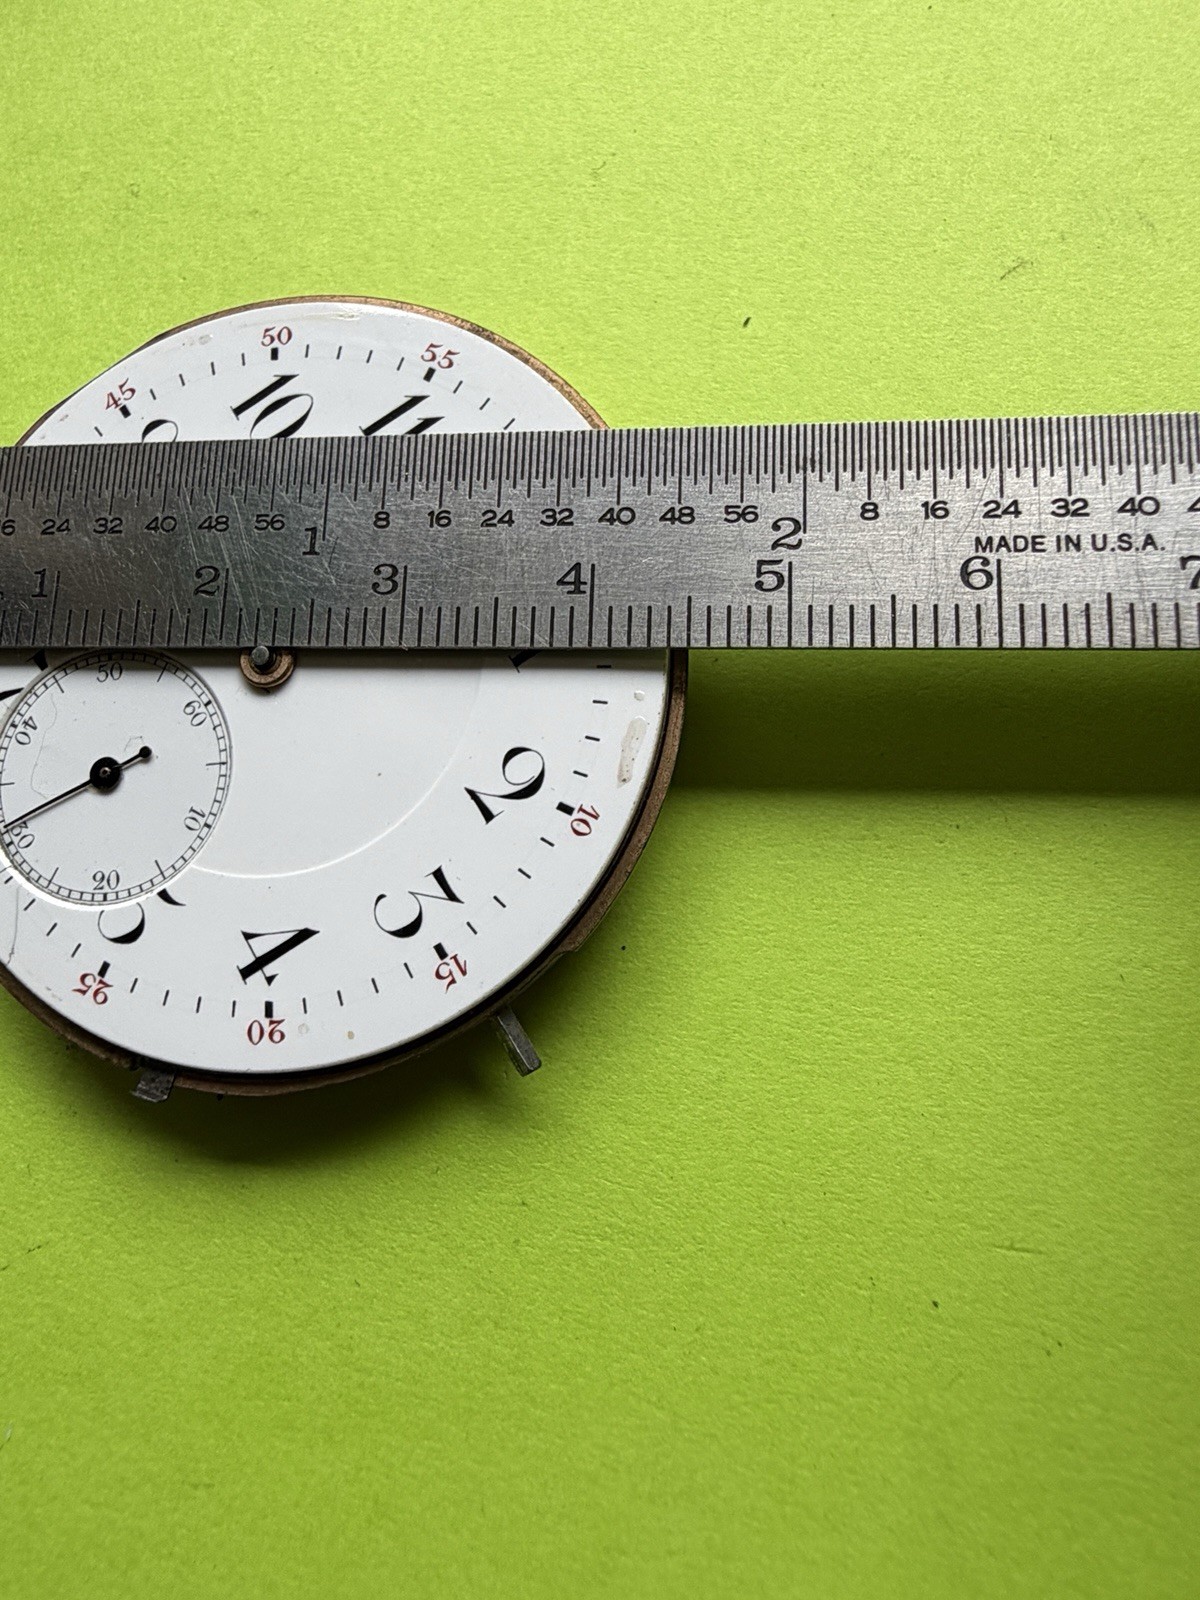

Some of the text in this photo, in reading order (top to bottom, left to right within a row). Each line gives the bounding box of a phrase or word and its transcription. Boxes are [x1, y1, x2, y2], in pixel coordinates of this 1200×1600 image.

[261, 326, 293, 347] 50
[421, 343, 460, 369] 55
[105, 377, 136, 410] 45
[230, 373, 314, 439] 10
[1, 496, 1161, 537] 6 24 32 40 48 56 8 16 24 32 40 48 56 8 16 24 32 40
[302, 526, 321, 556] 1
[771, 517, 803, 551] 2
[974, 533, 1166, 553] MADE IN U.S.A.
[31, 568, 48, 598] 1
[193, 565, 221, 597] 2
[371, 563, 399, 595] 3
[556, 561, 588, 595] 4
[754, 559, 785, 592] 5
[960, 555, 995, 590] 6
[96, 662, 123, 683] 50
[183, 699, 208, 727] 60
[15, 715, 38, 746] 40
[464, 746, 545, 825] 2
[183, 806, 207, 832] 10
[570, 803, 601, 837] 10
[92, 869, 120, 891] 20
[373, 864, 465, 939] 3
[236, 927, 320, 987] 4
[72, 972, 114, 1005] 25
[434, 954, 468, 994] 15
[246, 1018, 286, 1046] 20
